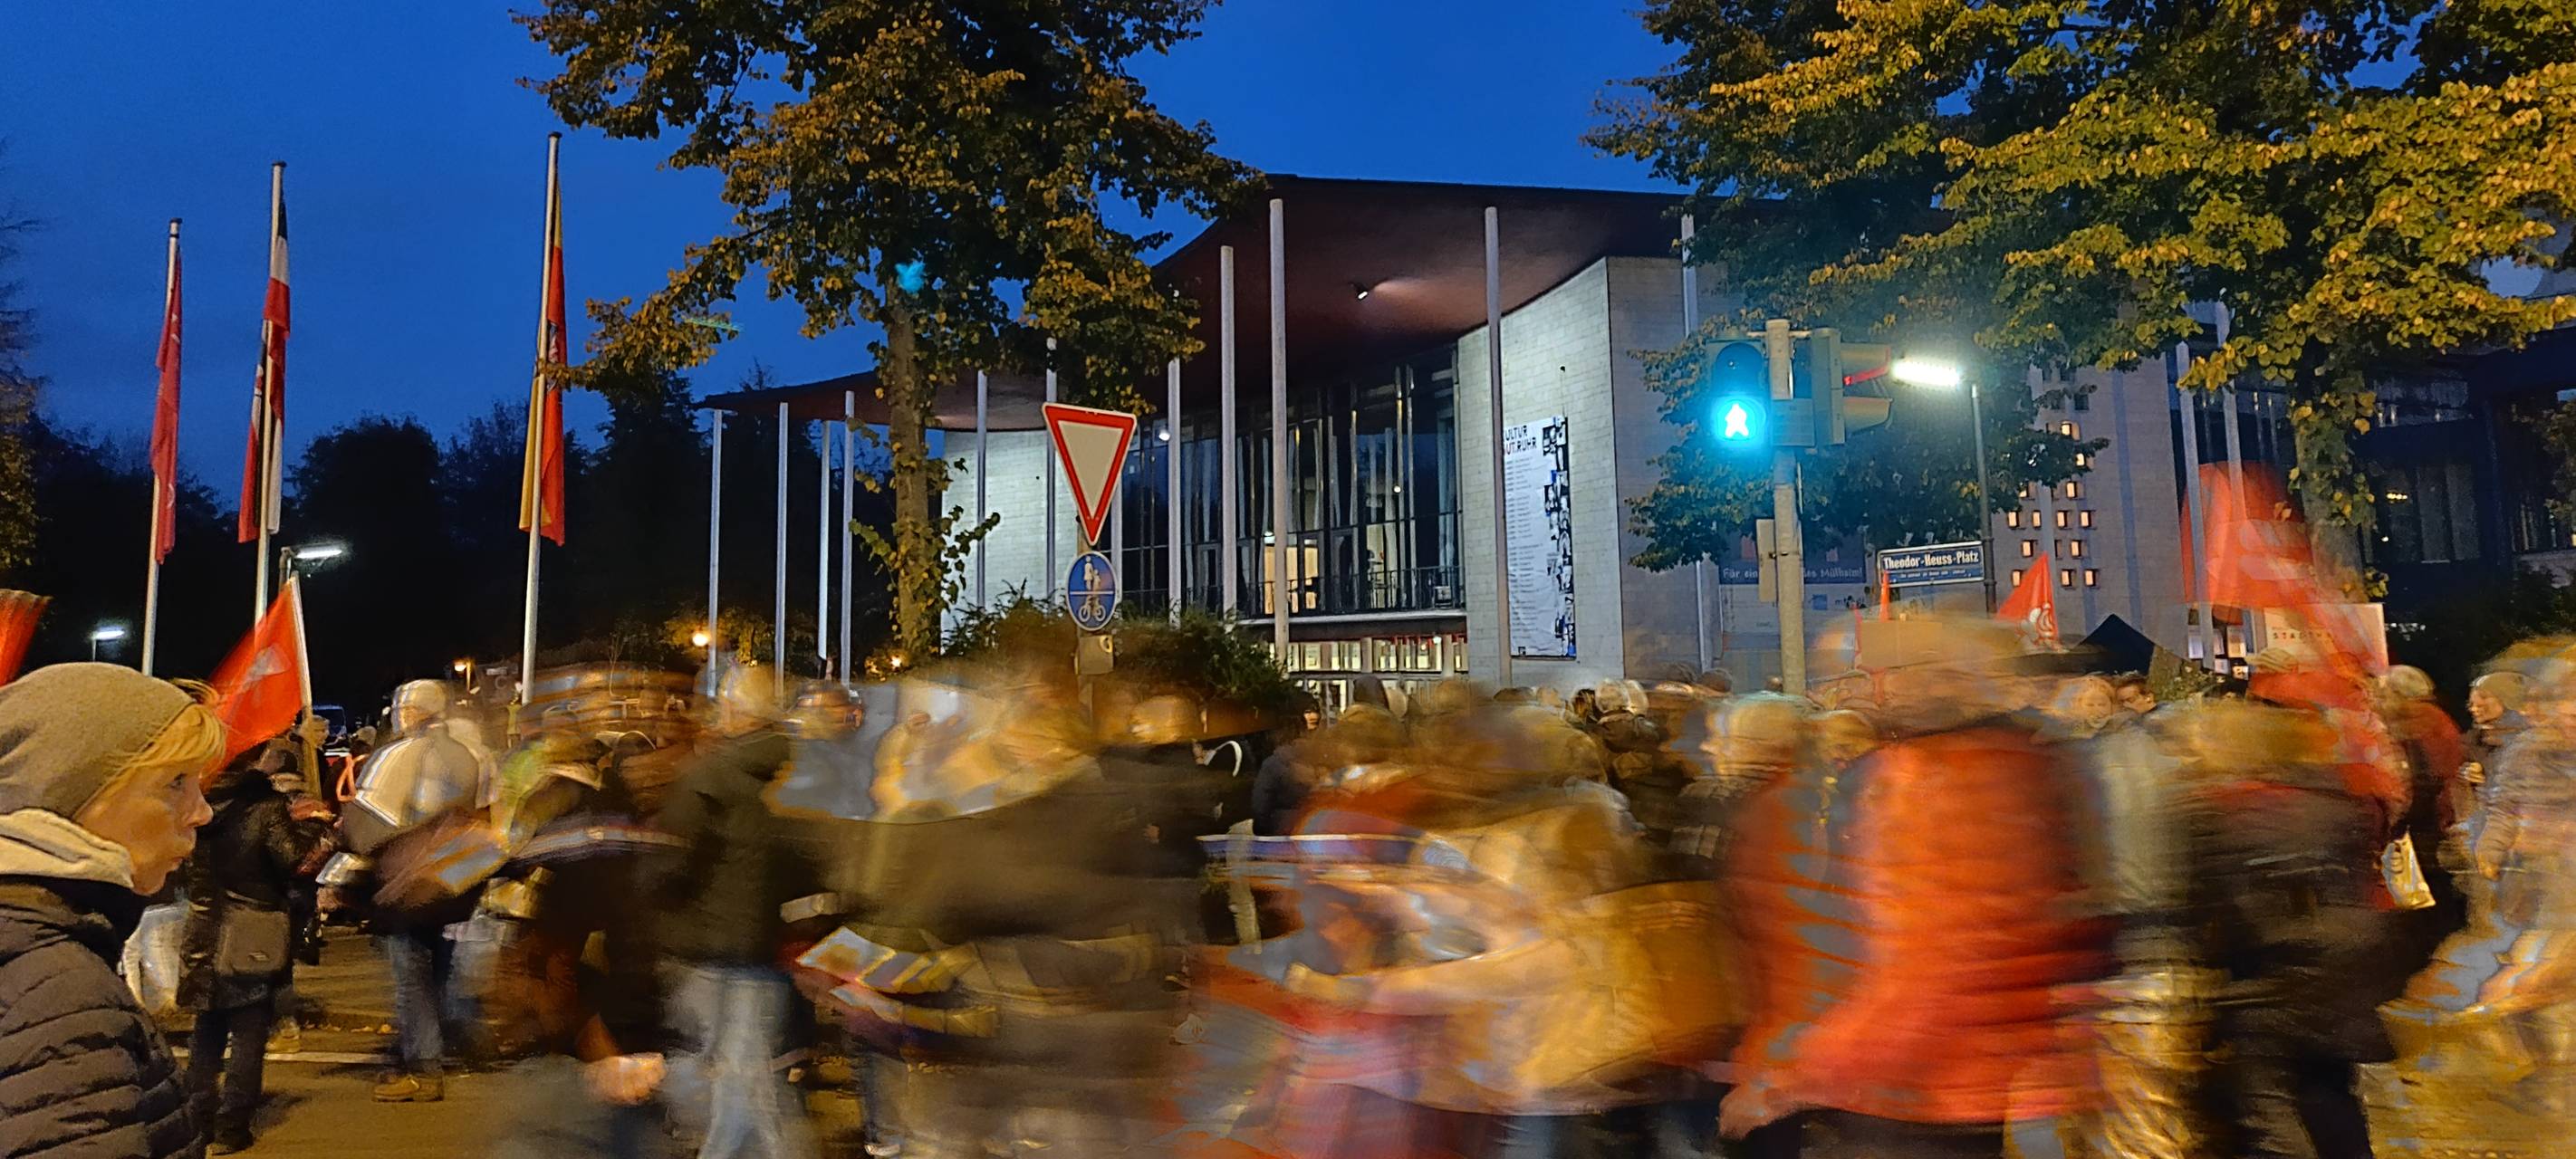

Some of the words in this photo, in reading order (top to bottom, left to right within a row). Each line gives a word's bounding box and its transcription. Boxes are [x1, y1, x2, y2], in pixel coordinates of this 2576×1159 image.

[1504, 425, 1528, 441] ULTUR
[1883, 551, 1979, 570] Theodor-Heuss-Platz
[1723, 567, 1740, 579] Für
